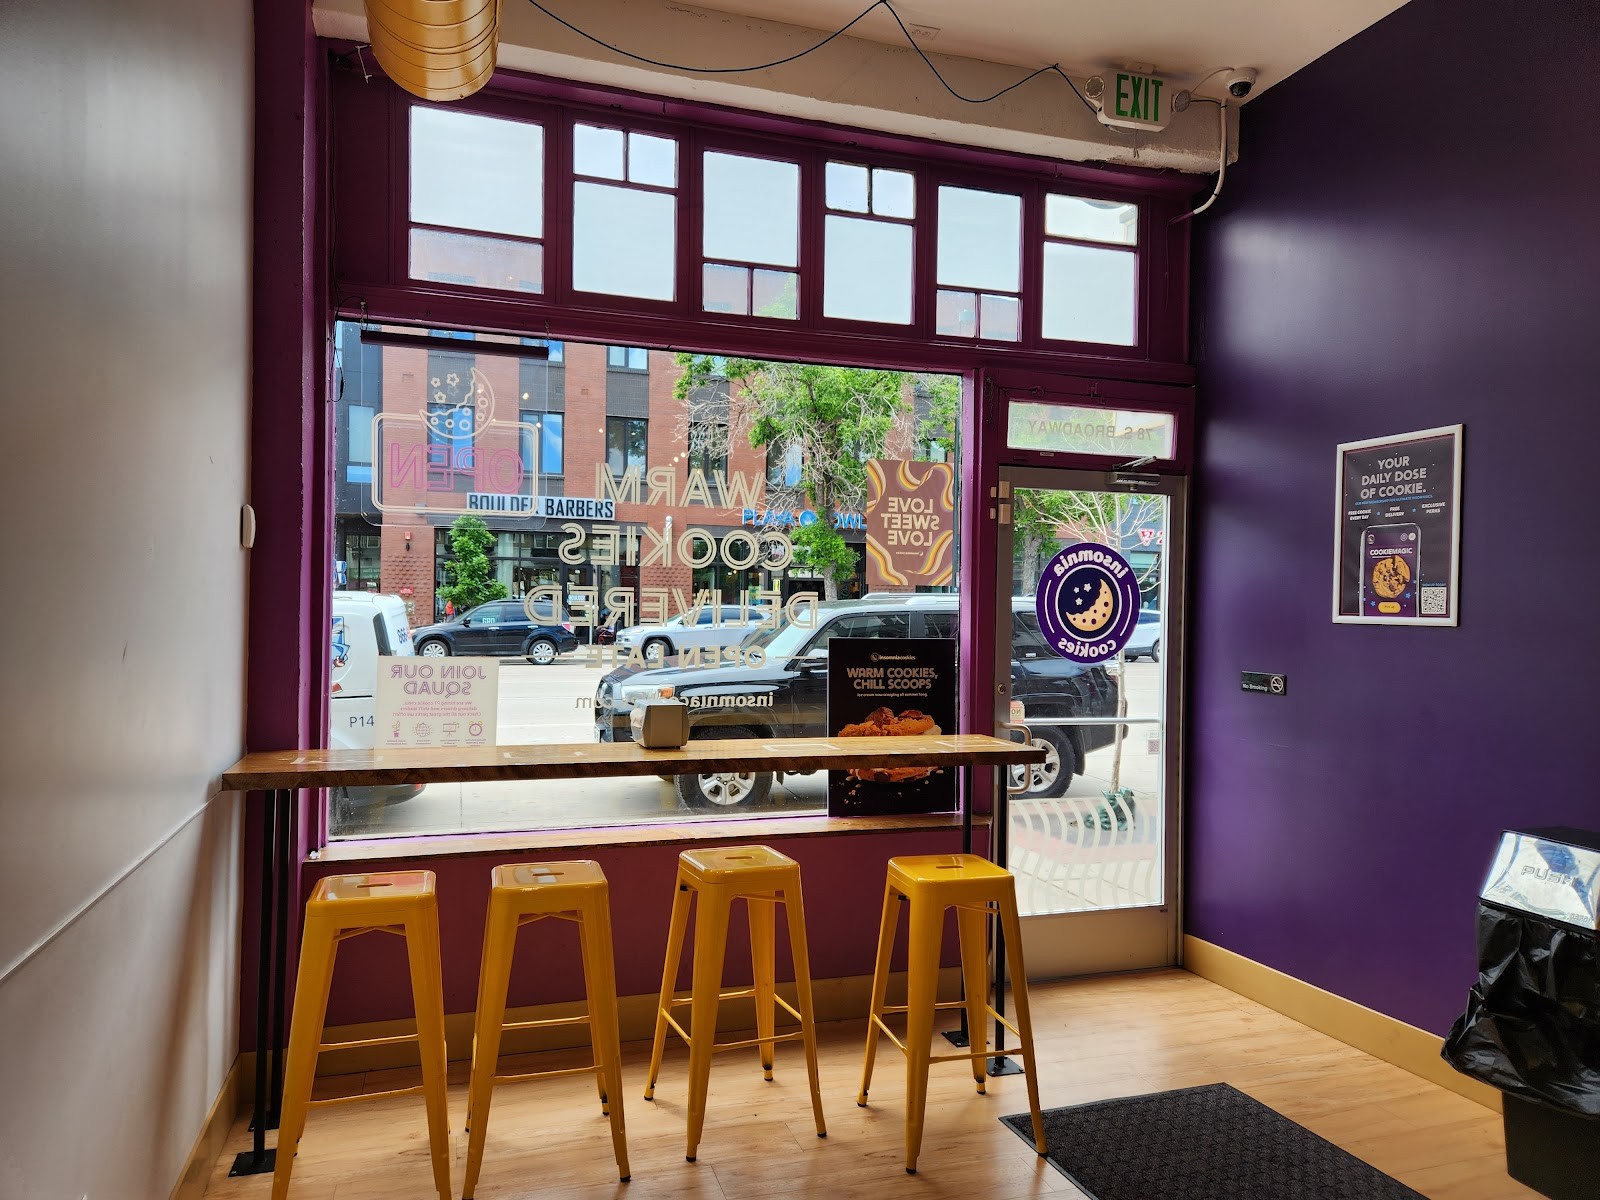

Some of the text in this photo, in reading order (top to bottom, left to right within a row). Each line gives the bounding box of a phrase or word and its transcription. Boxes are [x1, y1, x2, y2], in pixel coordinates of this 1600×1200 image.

[1115, 73, 1164, 122] EXIT
[1378, 455, 1410, 470] YOUR
[1361, 467, 1427, 486] DAILY DOSE
[1360, 482, 1427, 499] OF COOKIE.
[546, 498, 613, 519] BARBERS
[743, 507, 796, 527] PLAYA
[1369, 547, 1413, 556] COOKIEMAGIC
[846, 667, 938, 680] WARM COOKIES,
[853, 678, 932, 690] CHILL SCOOPS
[349, 715, 375, 728] P14
[1520, 865, 1577, 888] PUSH
